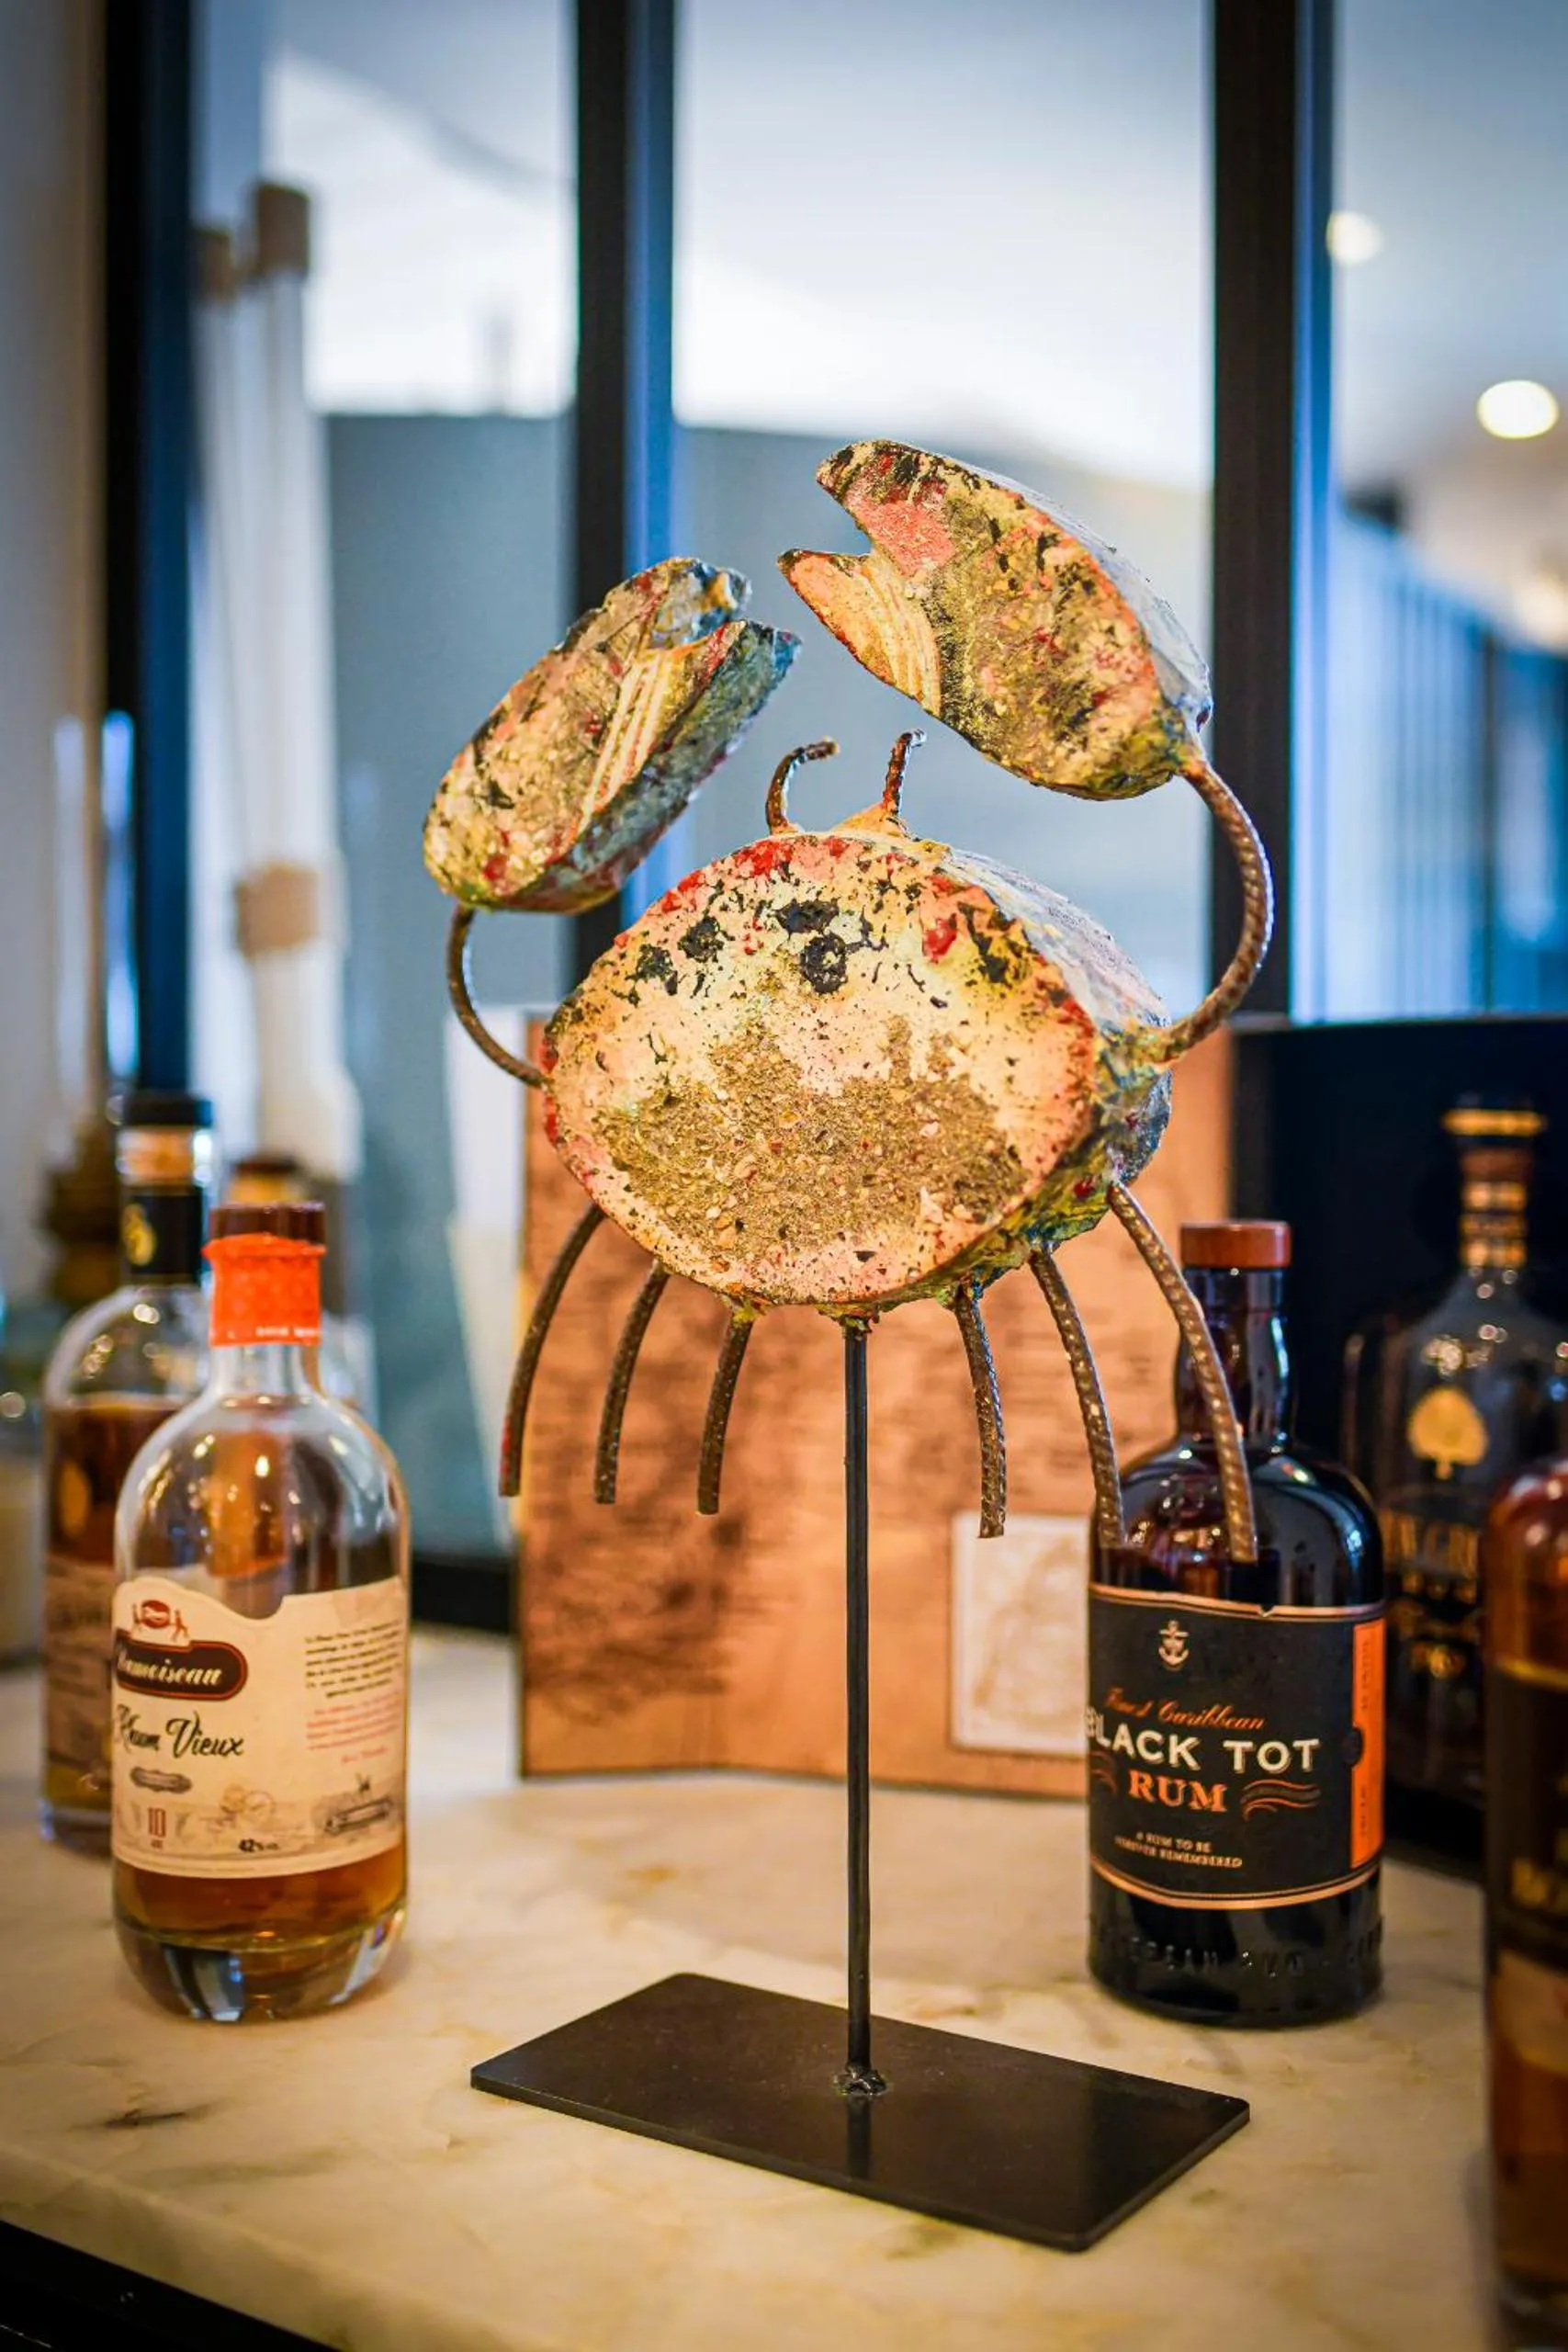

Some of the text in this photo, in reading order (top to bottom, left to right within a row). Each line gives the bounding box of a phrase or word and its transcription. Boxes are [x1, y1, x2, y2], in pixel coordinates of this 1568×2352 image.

[165, 1710, 244, 1758] Vieux
[1157, 1699, 1267, 1731] Caribbean
[1223, 1737, 1321, 1774] TOT
[1128, 1769, 1228, 1813] RUM
